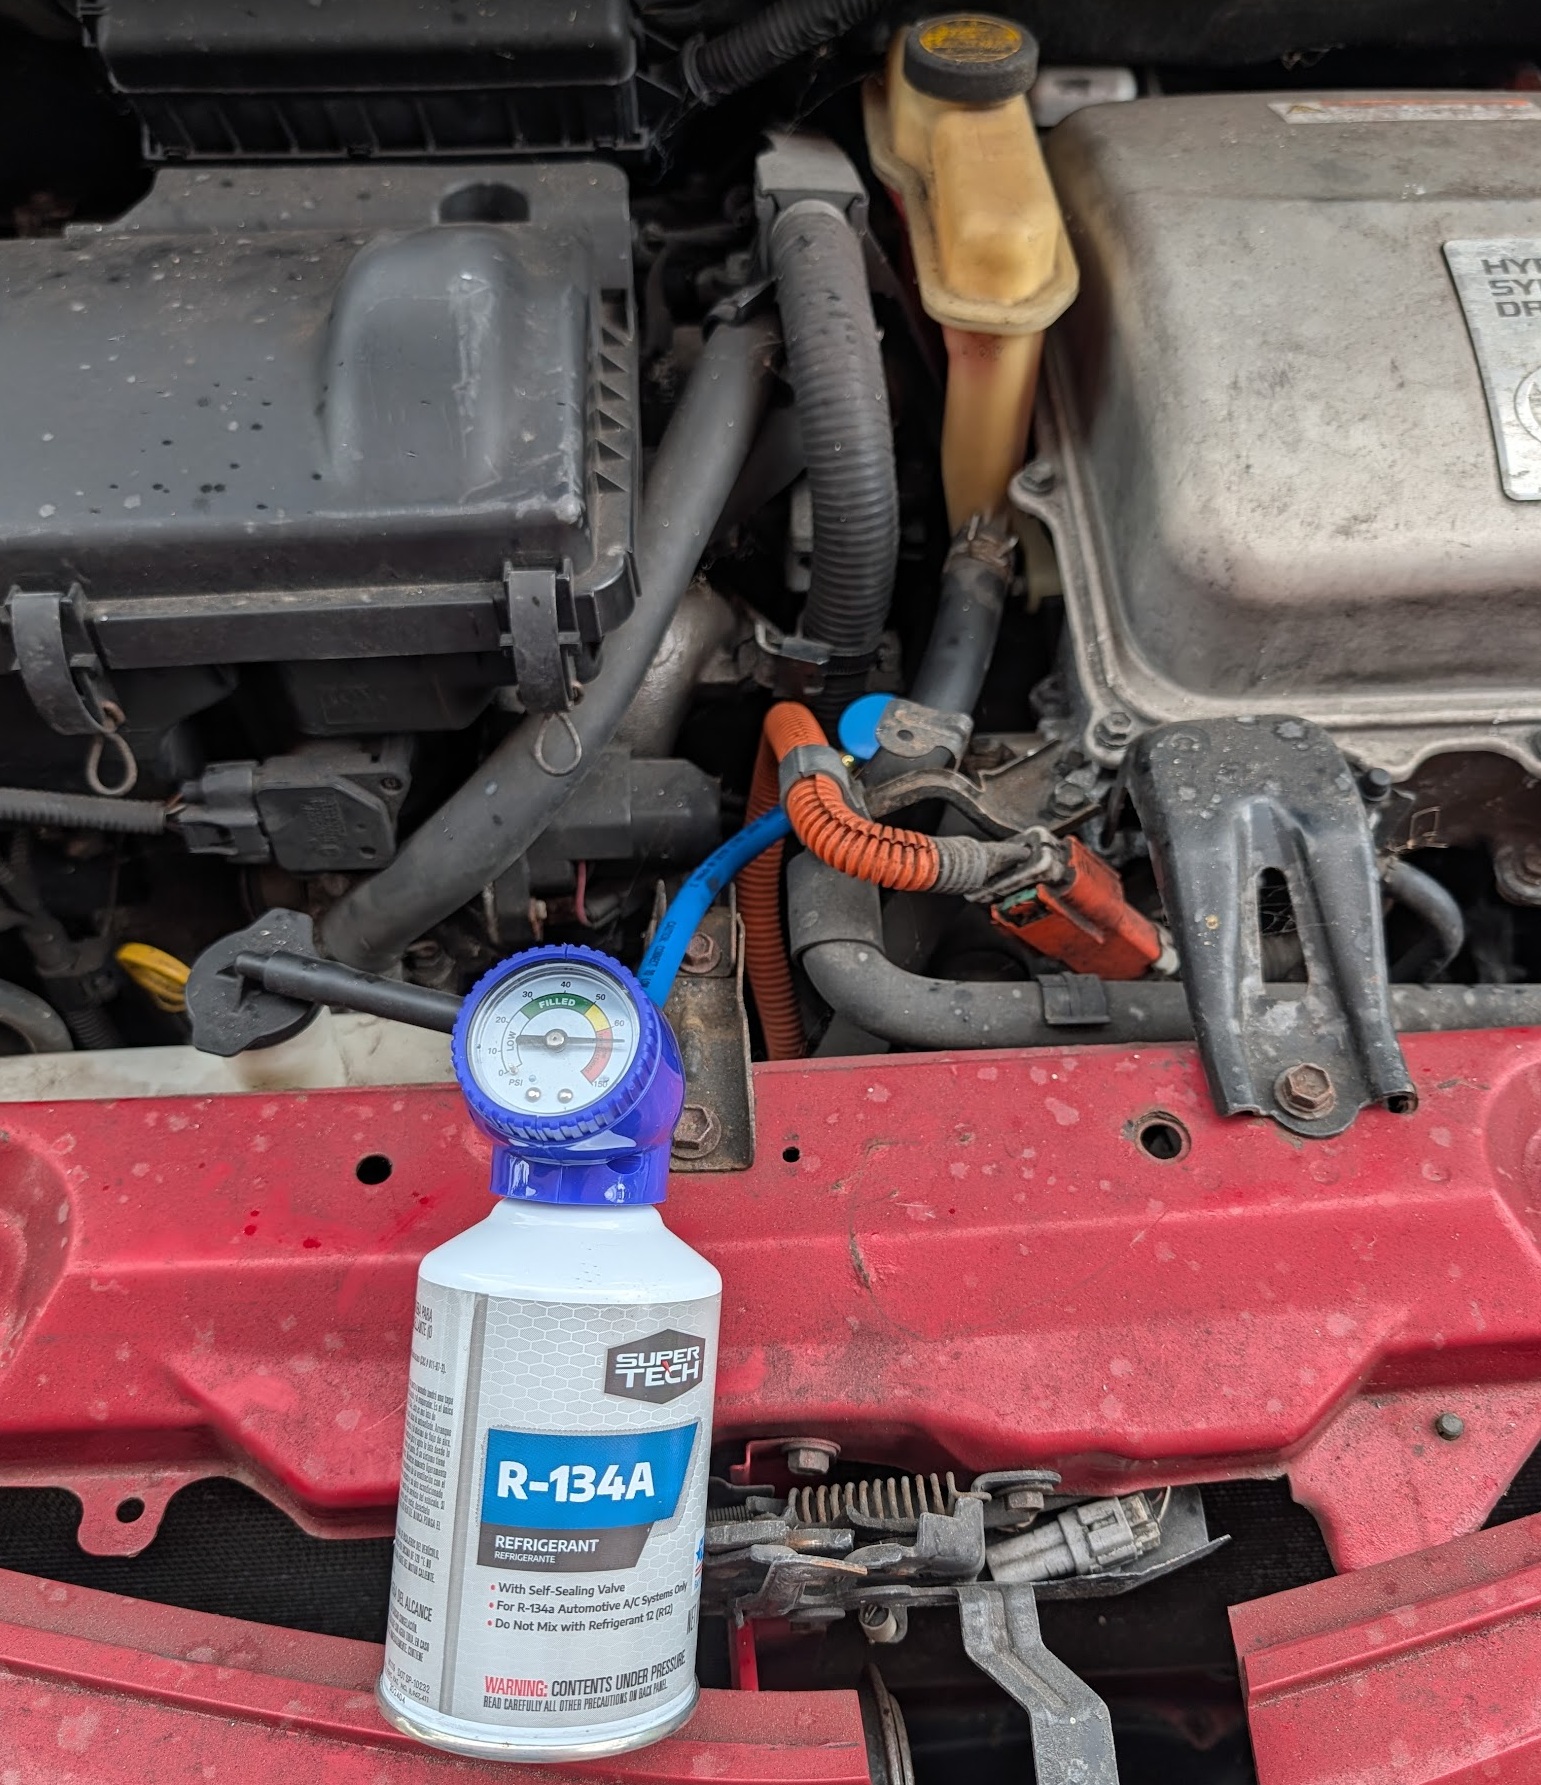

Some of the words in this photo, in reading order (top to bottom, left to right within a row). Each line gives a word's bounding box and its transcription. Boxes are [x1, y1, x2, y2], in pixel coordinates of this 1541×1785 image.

[560, 981, 571, 989] 40
[522, 990, 533, 998] 30
[595, 993, 606, 1001] 50
[538, 998, 576, 1009] FILLED
[495, 1016, 506, 1024] 20
[614, 1019, 625, 1028] 60
[506, 1030, 518, 1051] LOW
[487, 1047, 497, 1055] 10
[498, 1069, 504, 1077] 0
[508, 1078, 523, 1087] PSI
[594, 1080, 608, 1088] 150
[615, 1346, 700, 1368] SUPER
[614, 1360, 700, 1388] TECH
[497, 1460, 655, 1502] R-134A
[494, 1535, 599, 1553] REFRIGERANT
[494, 1550, 556, 1564] REFRIGERANTE
[496, 1600, 515, 1612] For
[517, 1602, 555, 1614] R-134a
[557, 1601, 621, 1614] Automotive
[622, 1596, 640, 1610] A/C
[641, 1588, 674, 1607] Systems
[674, 1580, 688, 1594] Only
[498, 1582, 526, 1595] With
[528, 1585, 595, 1598] Self-Sealing
[597, 1583, 625, 1595] Valve
[404, 1595, 433, 1622] ALCANCE
[495, 1618, 510, 1629] Do
[513, 1620, 534, 1631] Not
[536, 1622, 558, 1632] Mix
[561, 1621, 585, 1632] with
[588, 1613, 644, 1631] Refrigerant
[646, 1610, 654, 1621] 12
[655, 1603, 673, 1620] (R12)
[485, 1675, 548, 1697] WARNING:
[551, 1675, 613, 1697] CONTENTS
[615, 1667, 649, 1690] UNDER
[483, 1695, 502, 1709] READ
[503, 1698, 543, 1712] CAREFULLY
[543, 1700, 557, 1712] ALL
[559, 1698, 582, 1712] OTHER
[583, 1691, 628, 1710] PRECAUTIONS
[628, 1688, 638, 1702] ON
[638, 1684, 653, 1700] BACK
